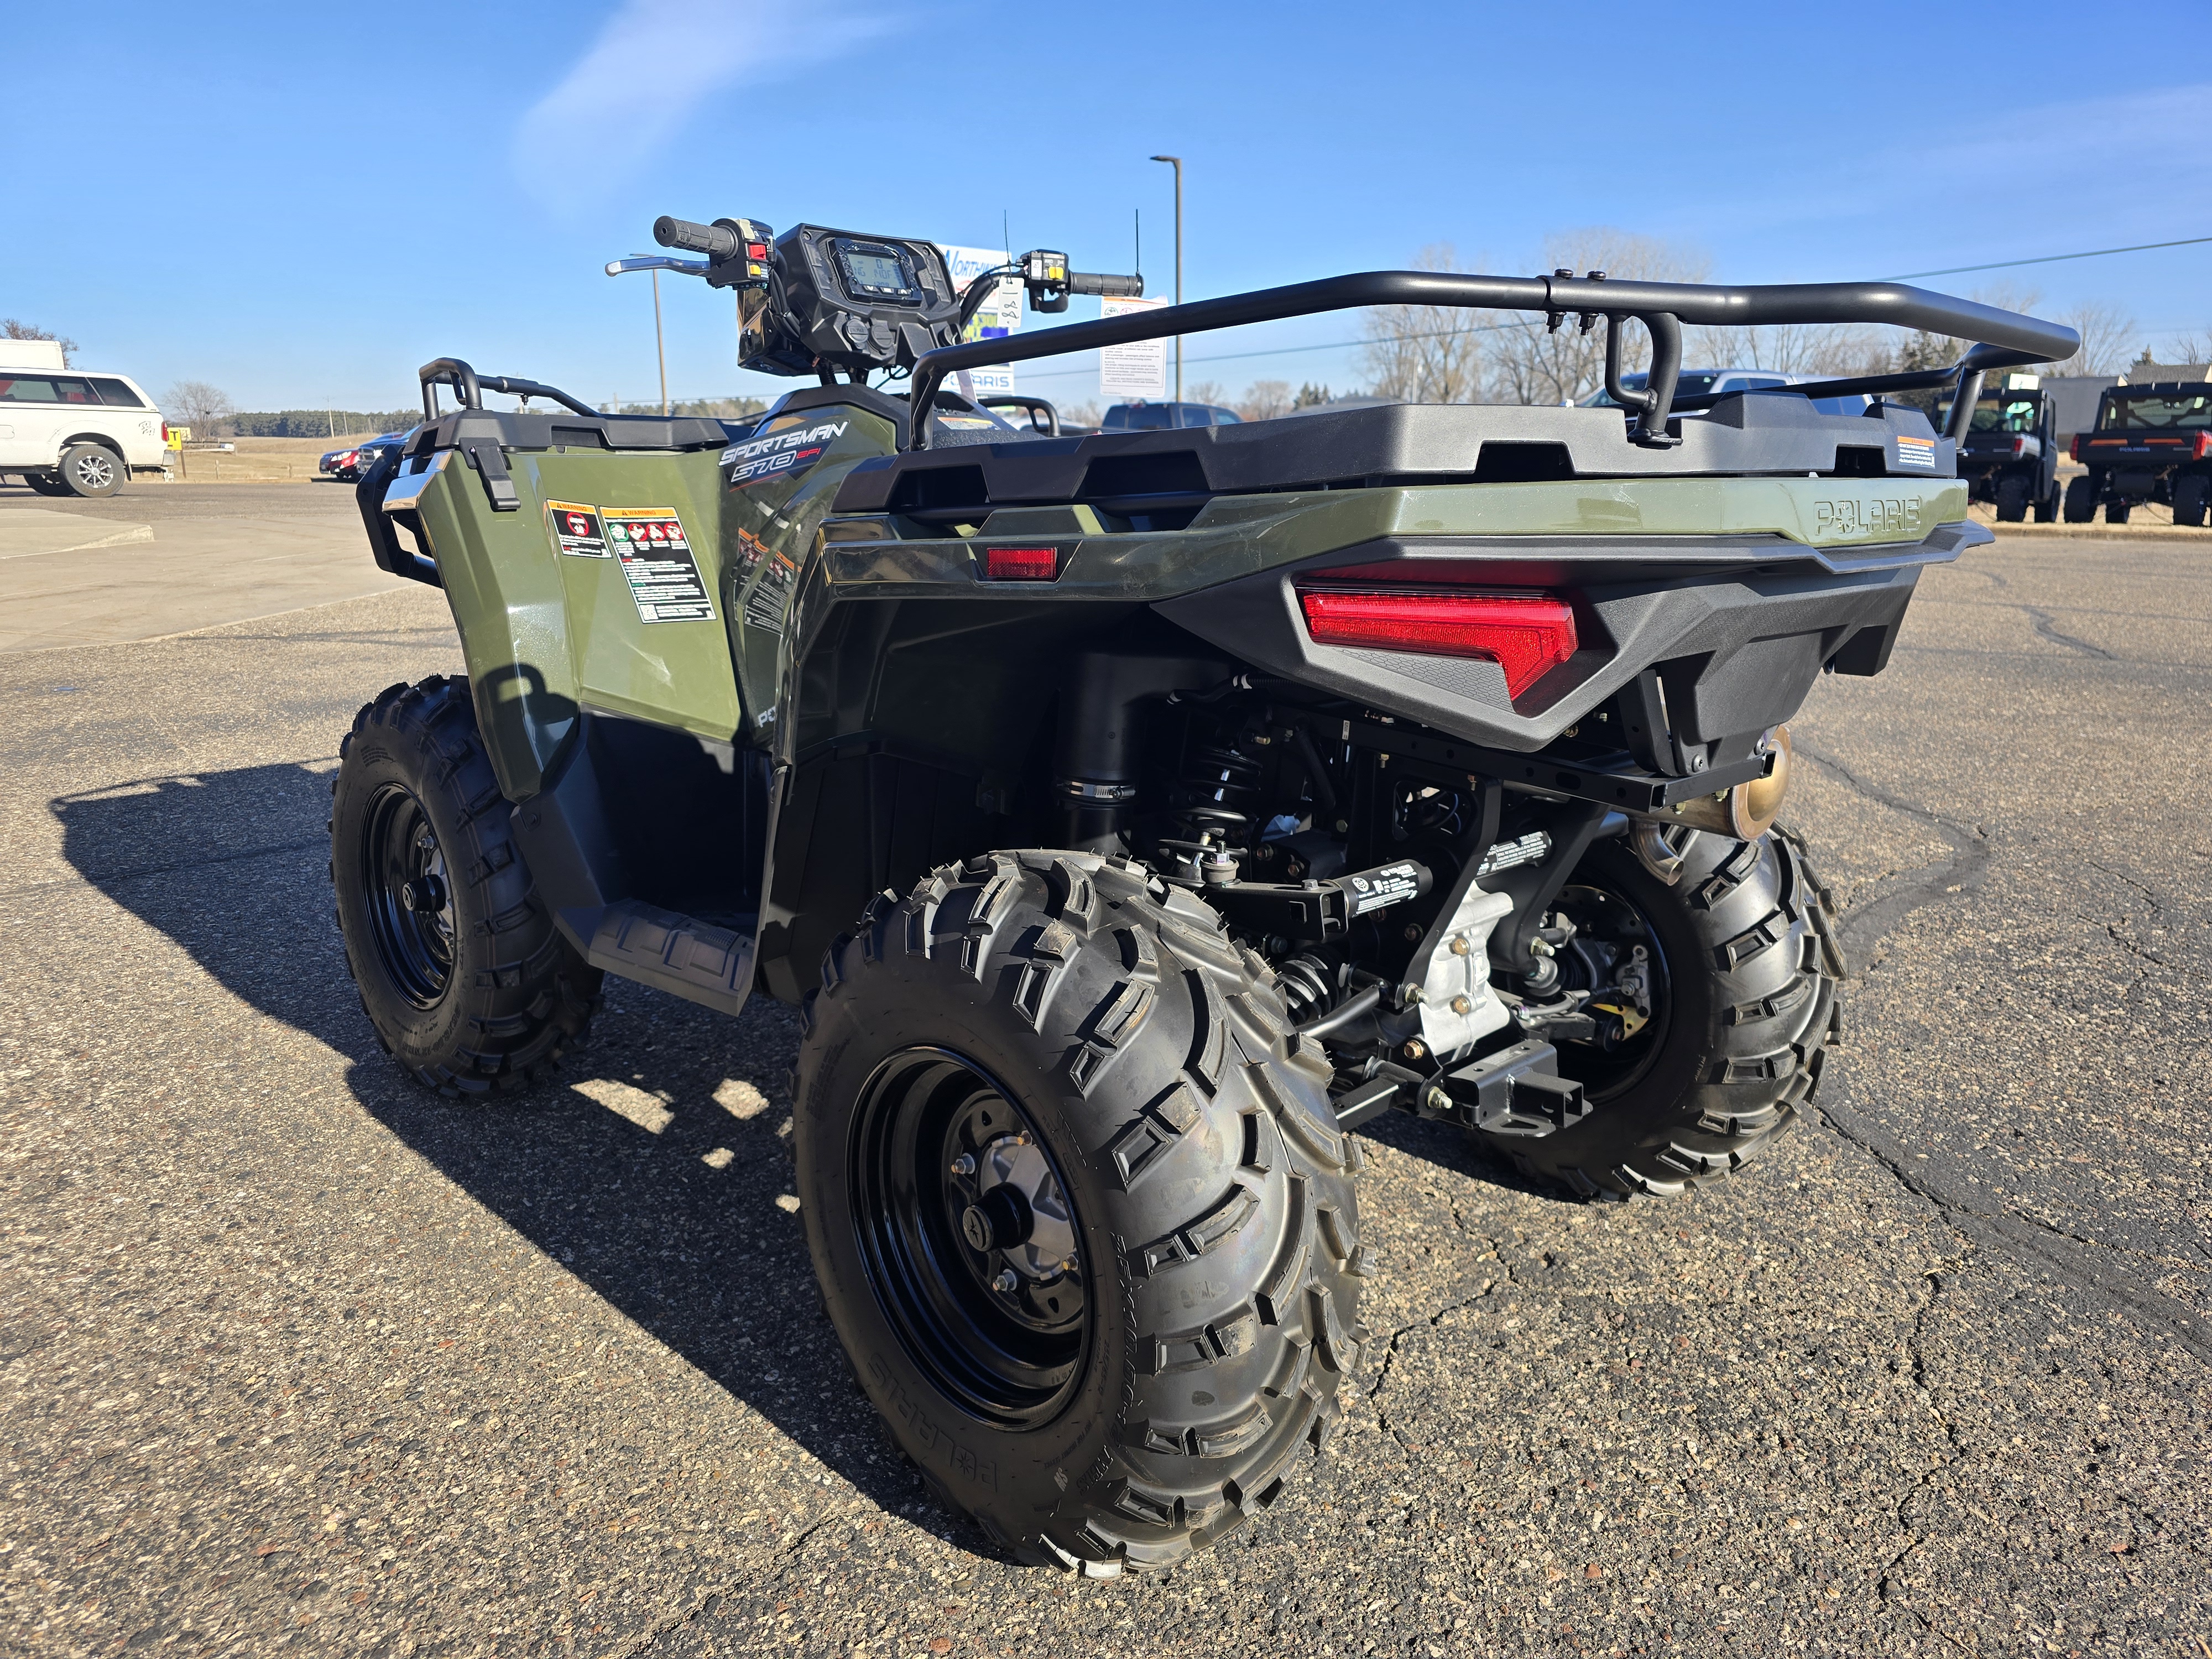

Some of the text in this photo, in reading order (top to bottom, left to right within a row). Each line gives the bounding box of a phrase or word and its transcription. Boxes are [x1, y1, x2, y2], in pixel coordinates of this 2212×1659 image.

[718, 421, 849, 466] SPORTSMAN
[731, 447, 821, 483] 570 EFI
[562, 503, 587, 512] WARNING
[1813, 499, 1921, 536] POLARIS
[866, 1353, 998, 1493] POLARIS
